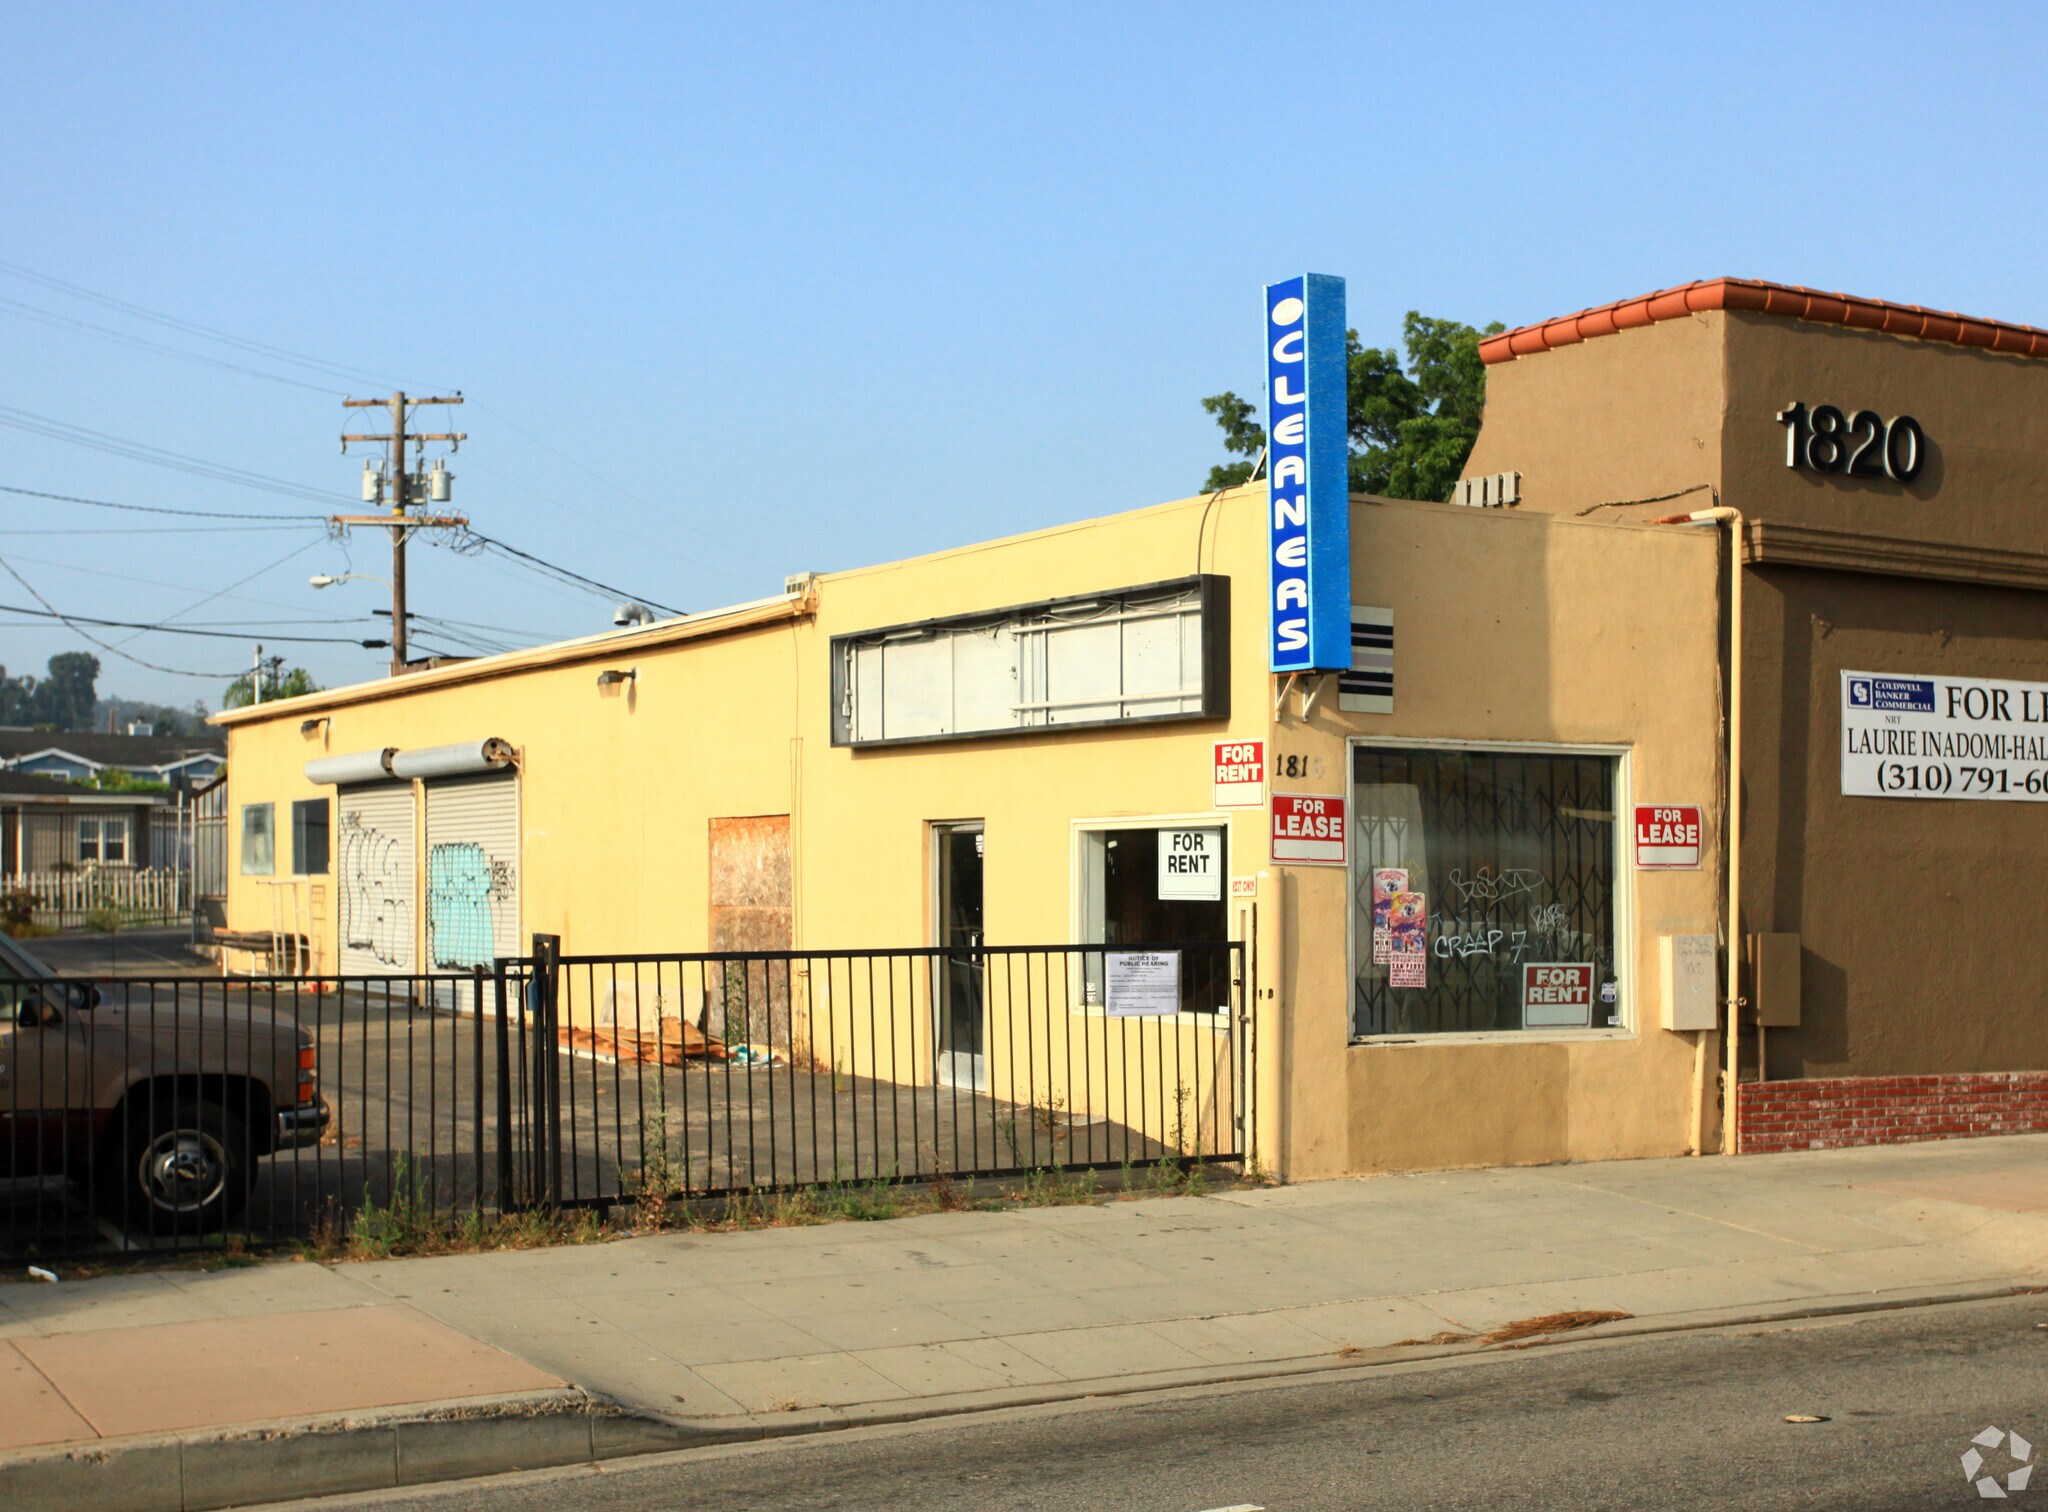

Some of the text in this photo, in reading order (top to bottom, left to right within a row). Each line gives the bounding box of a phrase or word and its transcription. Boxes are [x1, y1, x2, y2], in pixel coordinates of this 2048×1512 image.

[1776, 401, 1926, 484] 1820
[1273, 330, 1308, 652] CLEANERS
[1875, 681, 1923, 692] COLDWELL
[1875, 690, 1910, 701] BANKER
[1875, 700, 1933, 711] COMMERCIAL
[1945, 685, 2012, 721] FOR
[1885, 715, 1902, 725] NRT
[1848, 728, 1917, 757] LAURIE
[1221, 744, 1255, 764] FOR
[1216, 763, 1261, 782] RENT
[1877, 760, 1952, 795] (310)
[1293, 799, 1325, 814] FOR
[1653, 809, 1682, 823] FOR
[1274, 814, 1342, 838] LEASE
[1637, 823, 1698, 844] LEASE
[1173, 833, 1204, 851] FOR
[1168, 854, 1210, 873] RENT
[1536, 968, 1581, 986] FOR
[1529, 986, 1587, 1003] RENT
